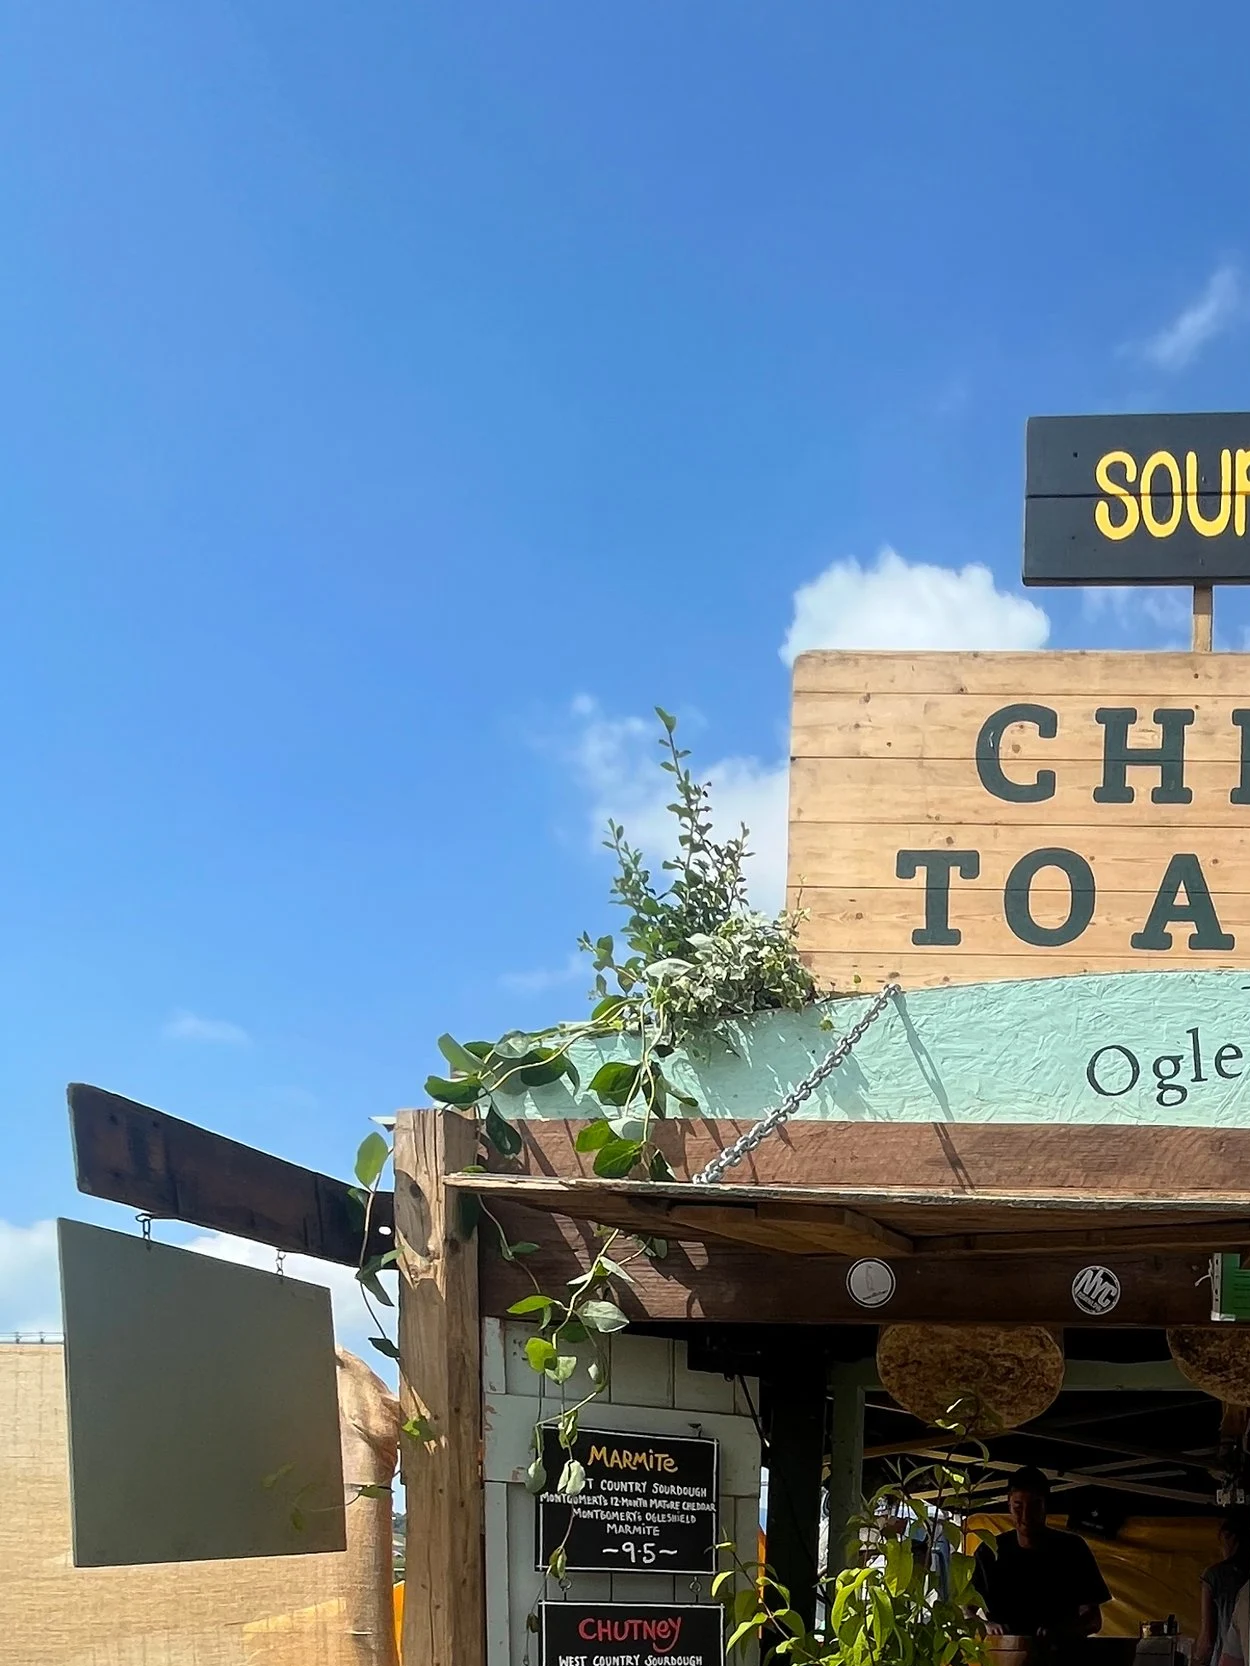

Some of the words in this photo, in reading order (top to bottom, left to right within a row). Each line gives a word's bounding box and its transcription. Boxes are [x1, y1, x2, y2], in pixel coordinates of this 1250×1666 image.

[1086, 1030, 1243, 1106] Ogle
[600, 1480, 647, 1493] COUNTRY
[652, 1483, 707, 1497] SOURDOUGH
[558, 1655, 587, 1666] WEST
[592, 1655, 640, 1666] COUNTRY
[644, 1655, 703, 1666] SOURDOUGH
